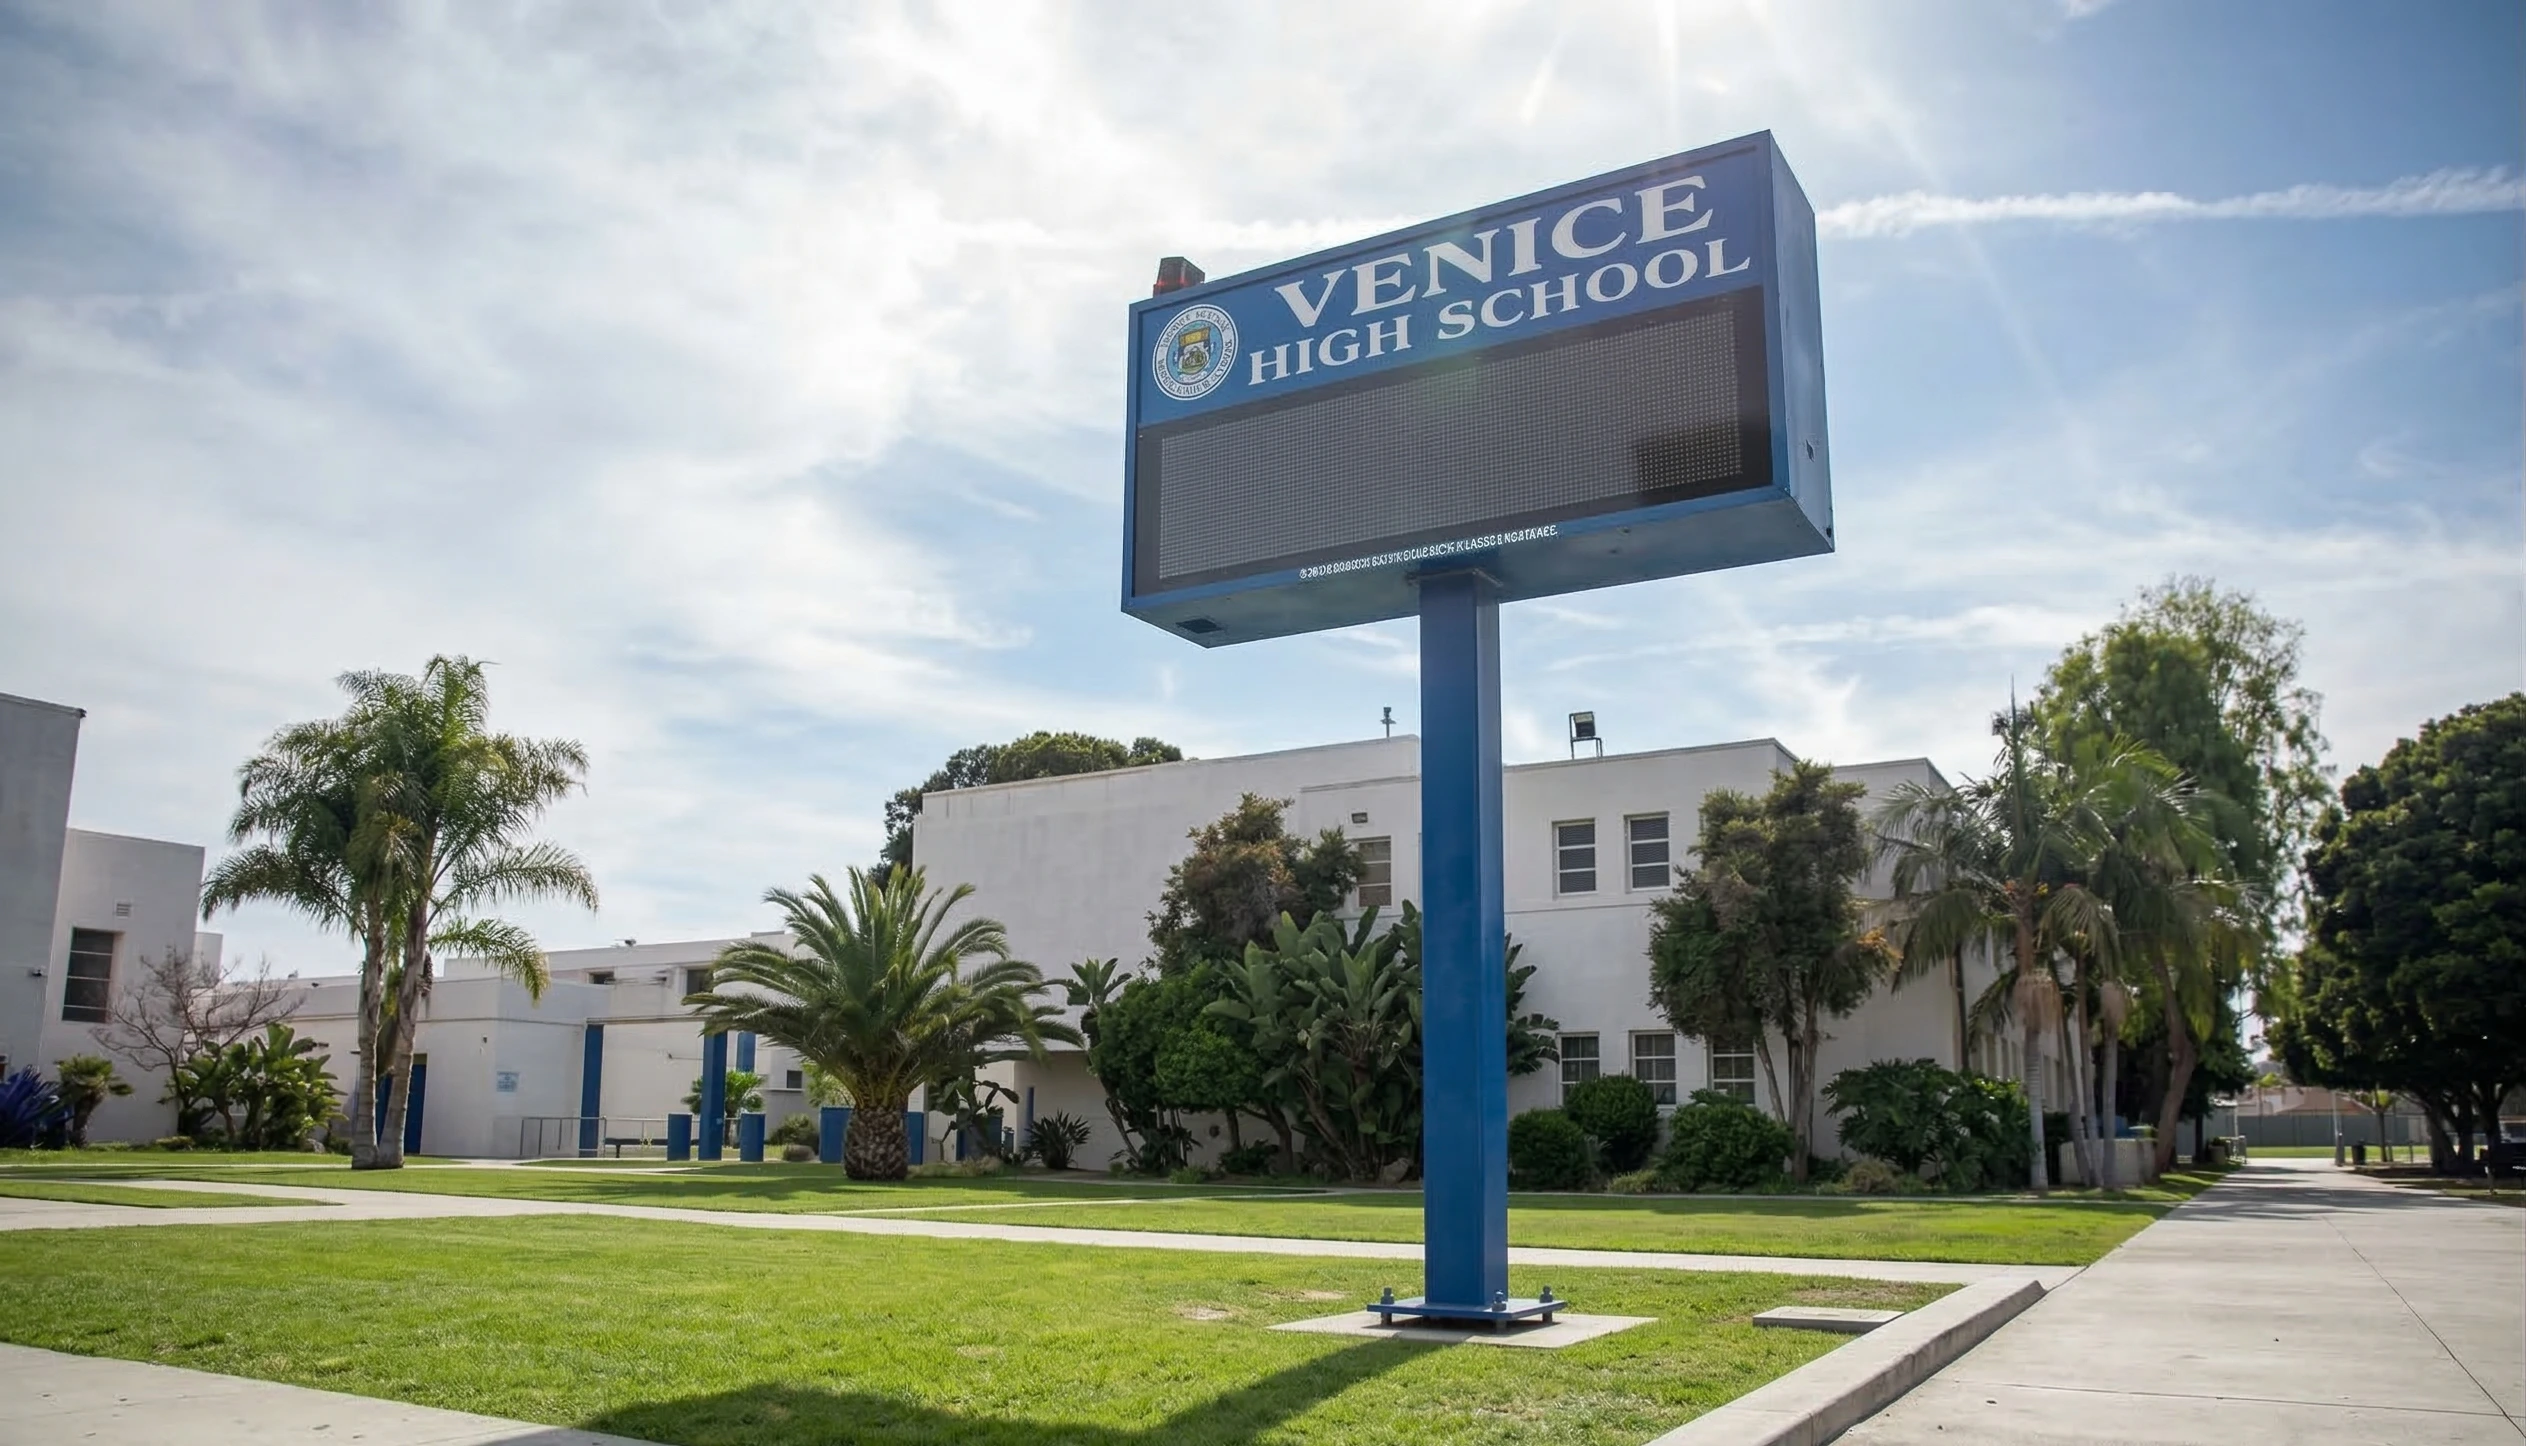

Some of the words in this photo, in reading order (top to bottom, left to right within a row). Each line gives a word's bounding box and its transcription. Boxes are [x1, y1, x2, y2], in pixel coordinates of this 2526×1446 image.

[1248, 314, 1412, 386] HIGH
[1437, 238, 1751, 340] SCHOOL
[1274, 175, 1714, 328] VENICE
